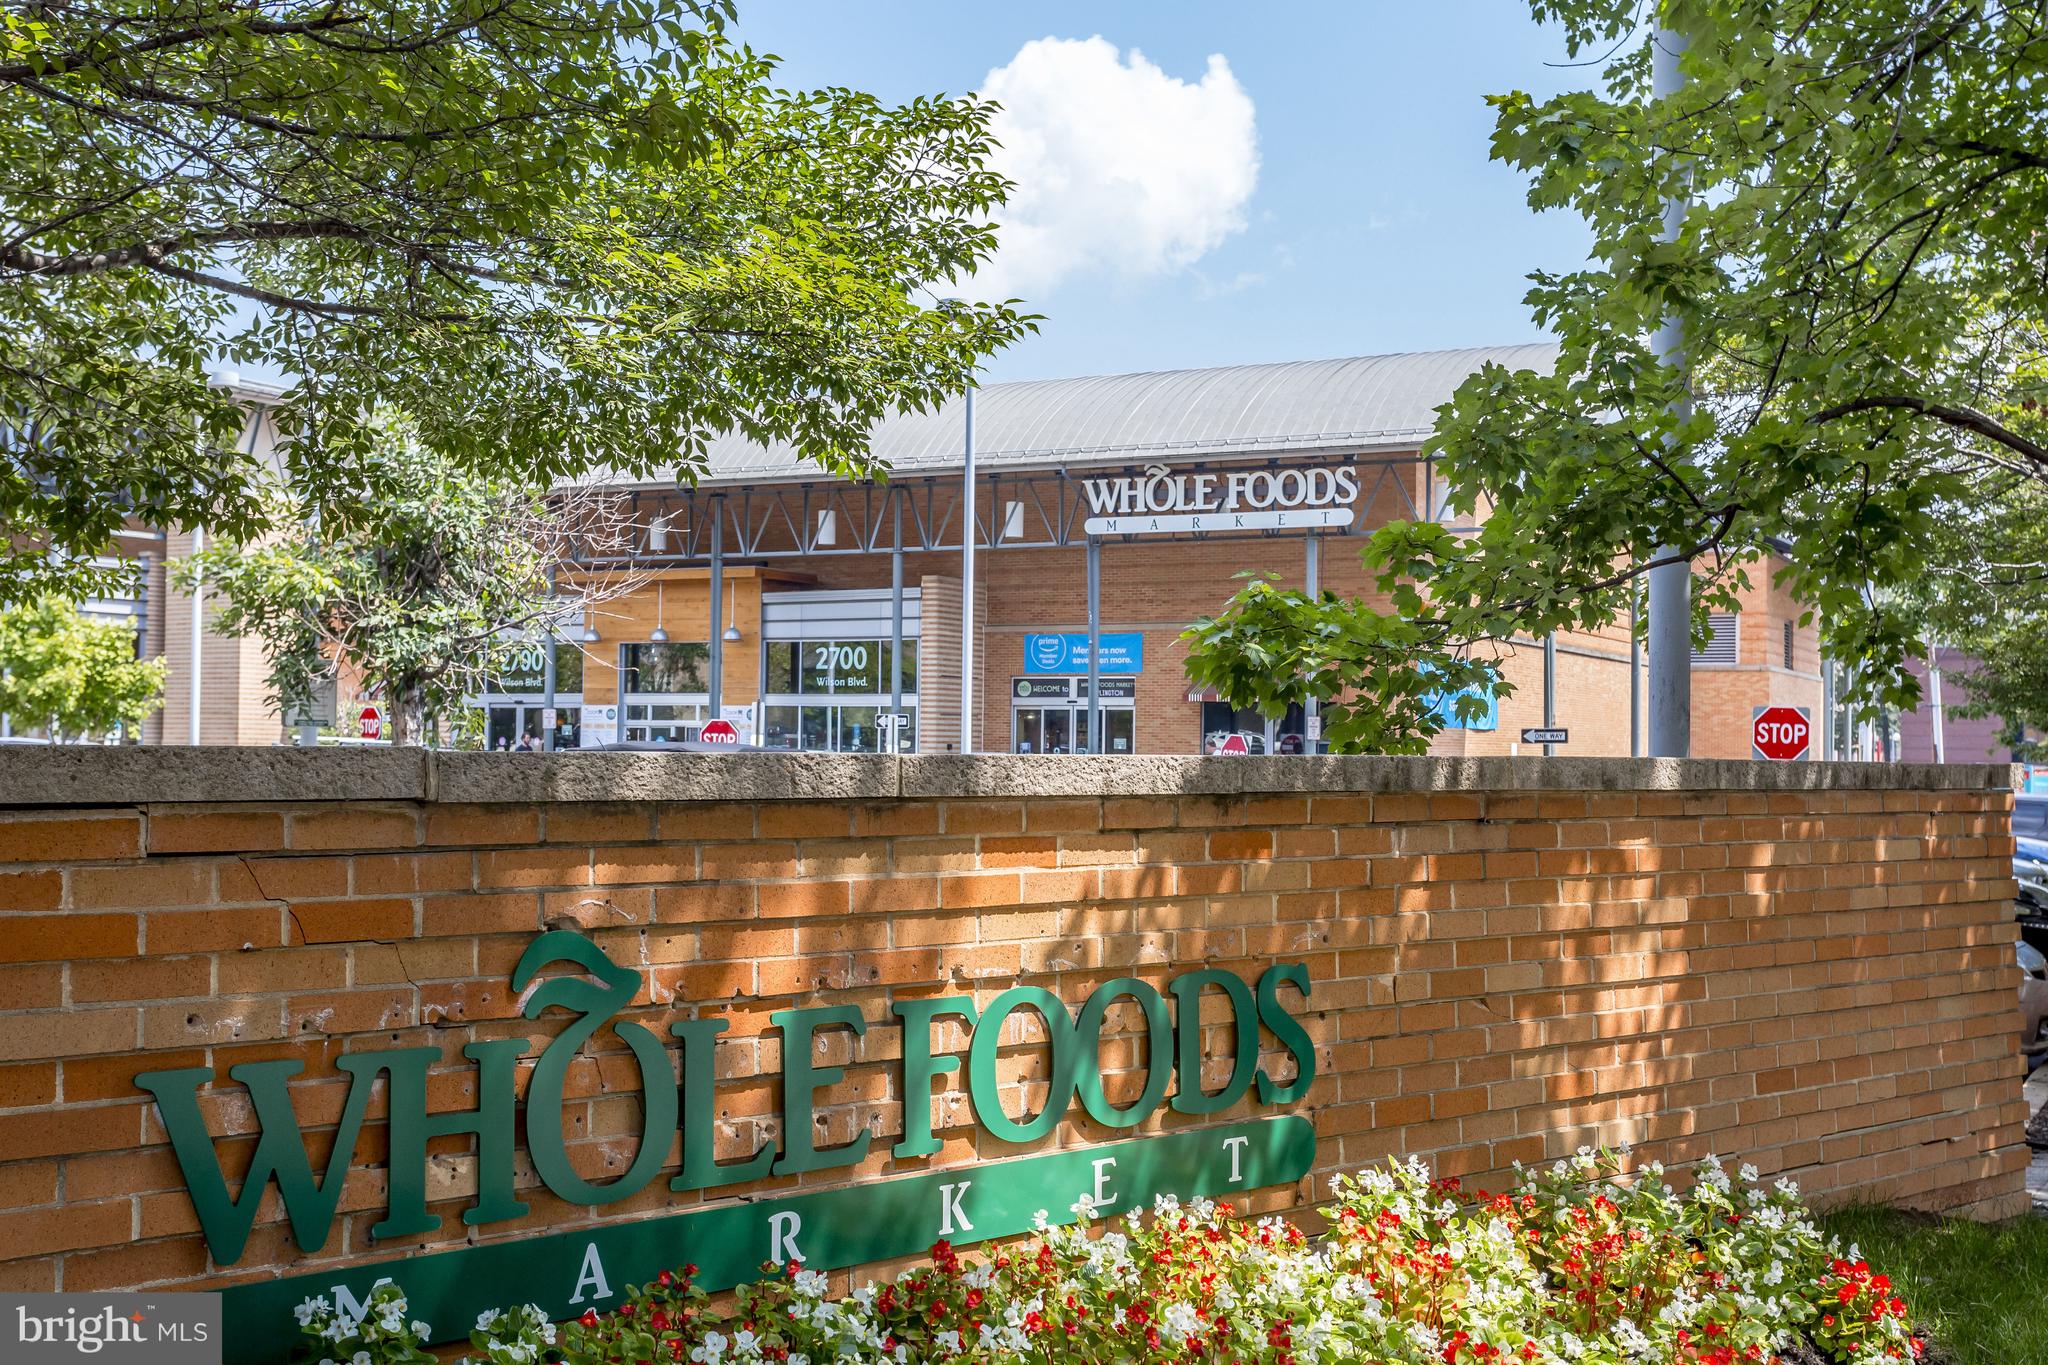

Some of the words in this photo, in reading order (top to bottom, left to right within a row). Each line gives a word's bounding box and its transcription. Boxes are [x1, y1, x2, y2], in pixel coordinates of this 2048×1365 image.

[1081, 463, 1217, 514] WHOLE
[1226, 466, 1358, 510] FOODS
[1106, 512, 1331, 532] MARKET
[1038, 637, 1059, 646] prime
[816, 646, 868, 670] 2700
[501, 677, 524, 687] Wilson
[526, 676, 543, 687] Blvd.
[816, 677, 845, 687] Wilson
[847, 676, 868, 687] Blvd.
[1033, 685, 1061, 693] WELCOME
[1062, 685, 1069, 693] to
[359, 718, 379, 734] STOP
[1757, 722, 1807, 744] STOP
[703, 732, 736, 744] STOP
[134, 931, 872, 1267] WHOLE
[891, 962, 1317, 1159] FOODS
